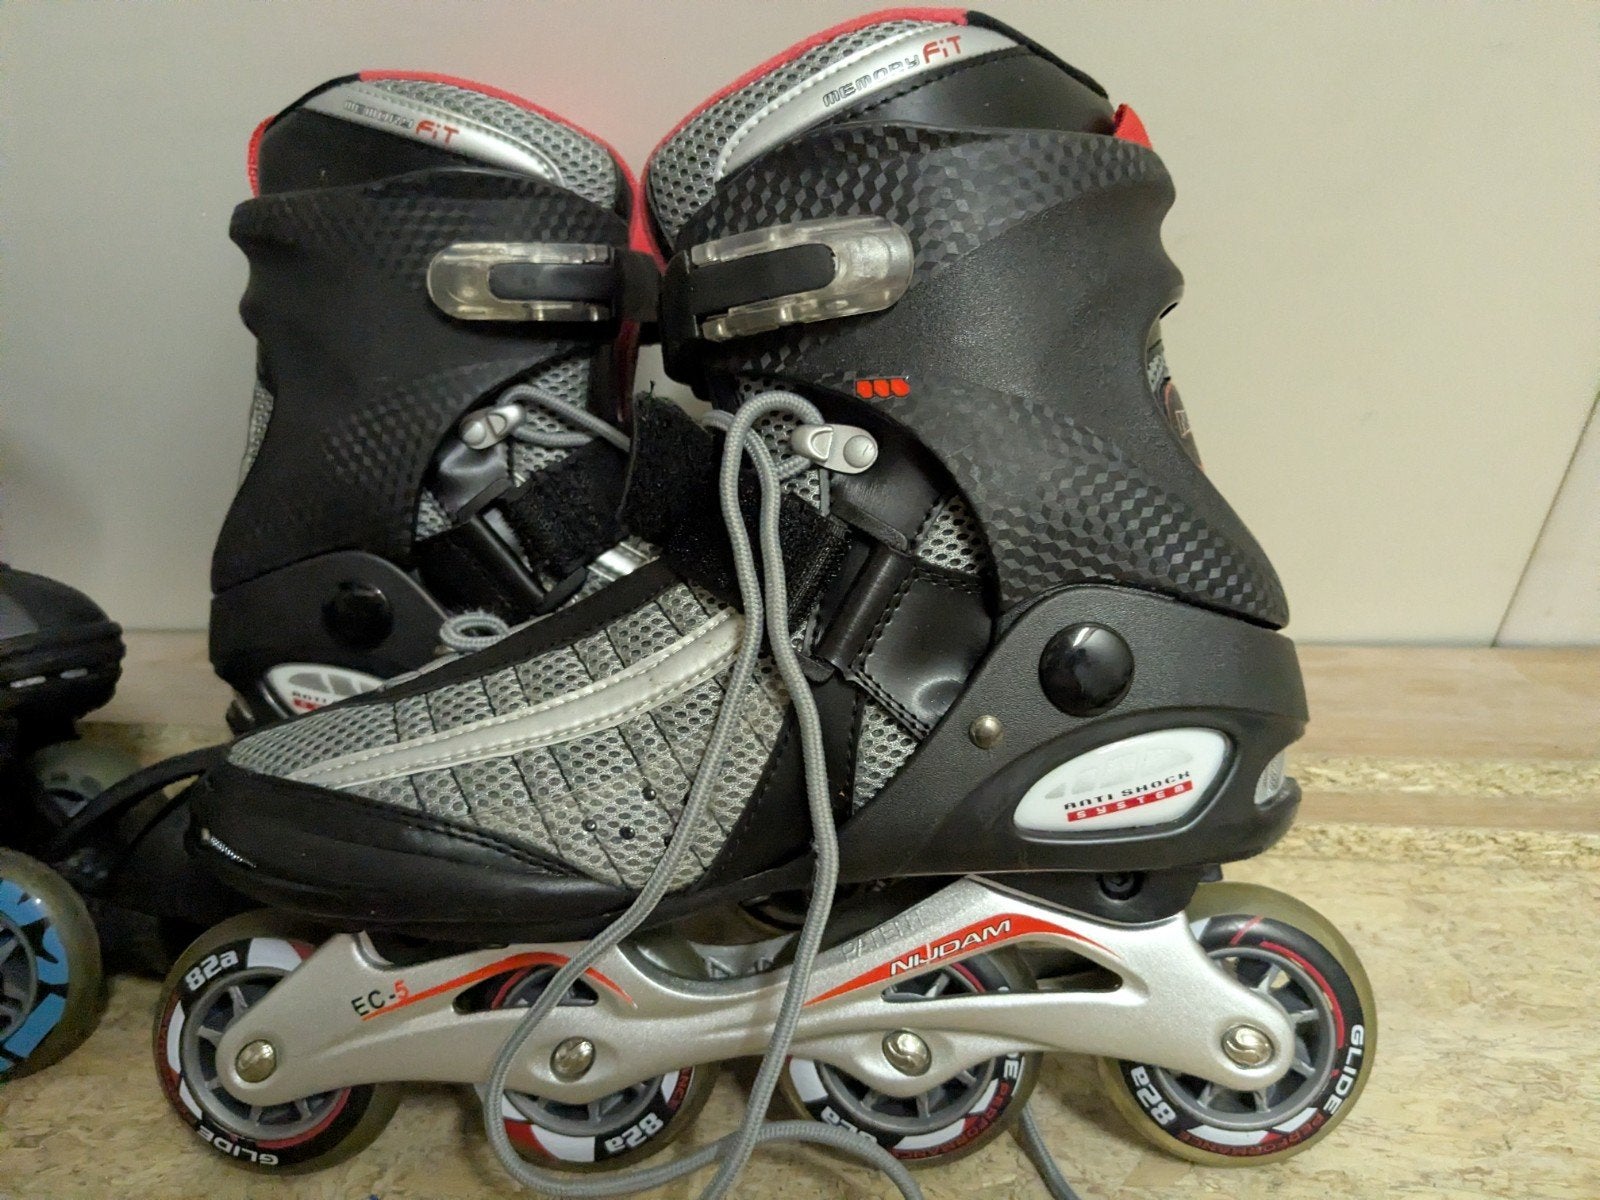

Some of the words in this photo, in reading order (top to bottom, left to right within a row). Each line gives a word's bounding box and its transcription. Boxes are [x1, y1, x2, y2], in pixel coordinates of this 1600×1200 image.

[823, 54, 920, 107] MEMORY
[1064, 793, 1114, 810] ANTI
[1121, 770, 1191, 797] SHOCK
[1076, 783, 1187, 820] SYSTEM
[890, 919, 1012, 976] NIJDAM
[184, 949, 239, 992] 82a
[1323, 1024, 1365, 1115] GLIDE
[1130, 1066, 1177, 1126] 82a
[197, 1125, 280, 1166] GLIDE
[604, 1111, 665, 1153] 82a
